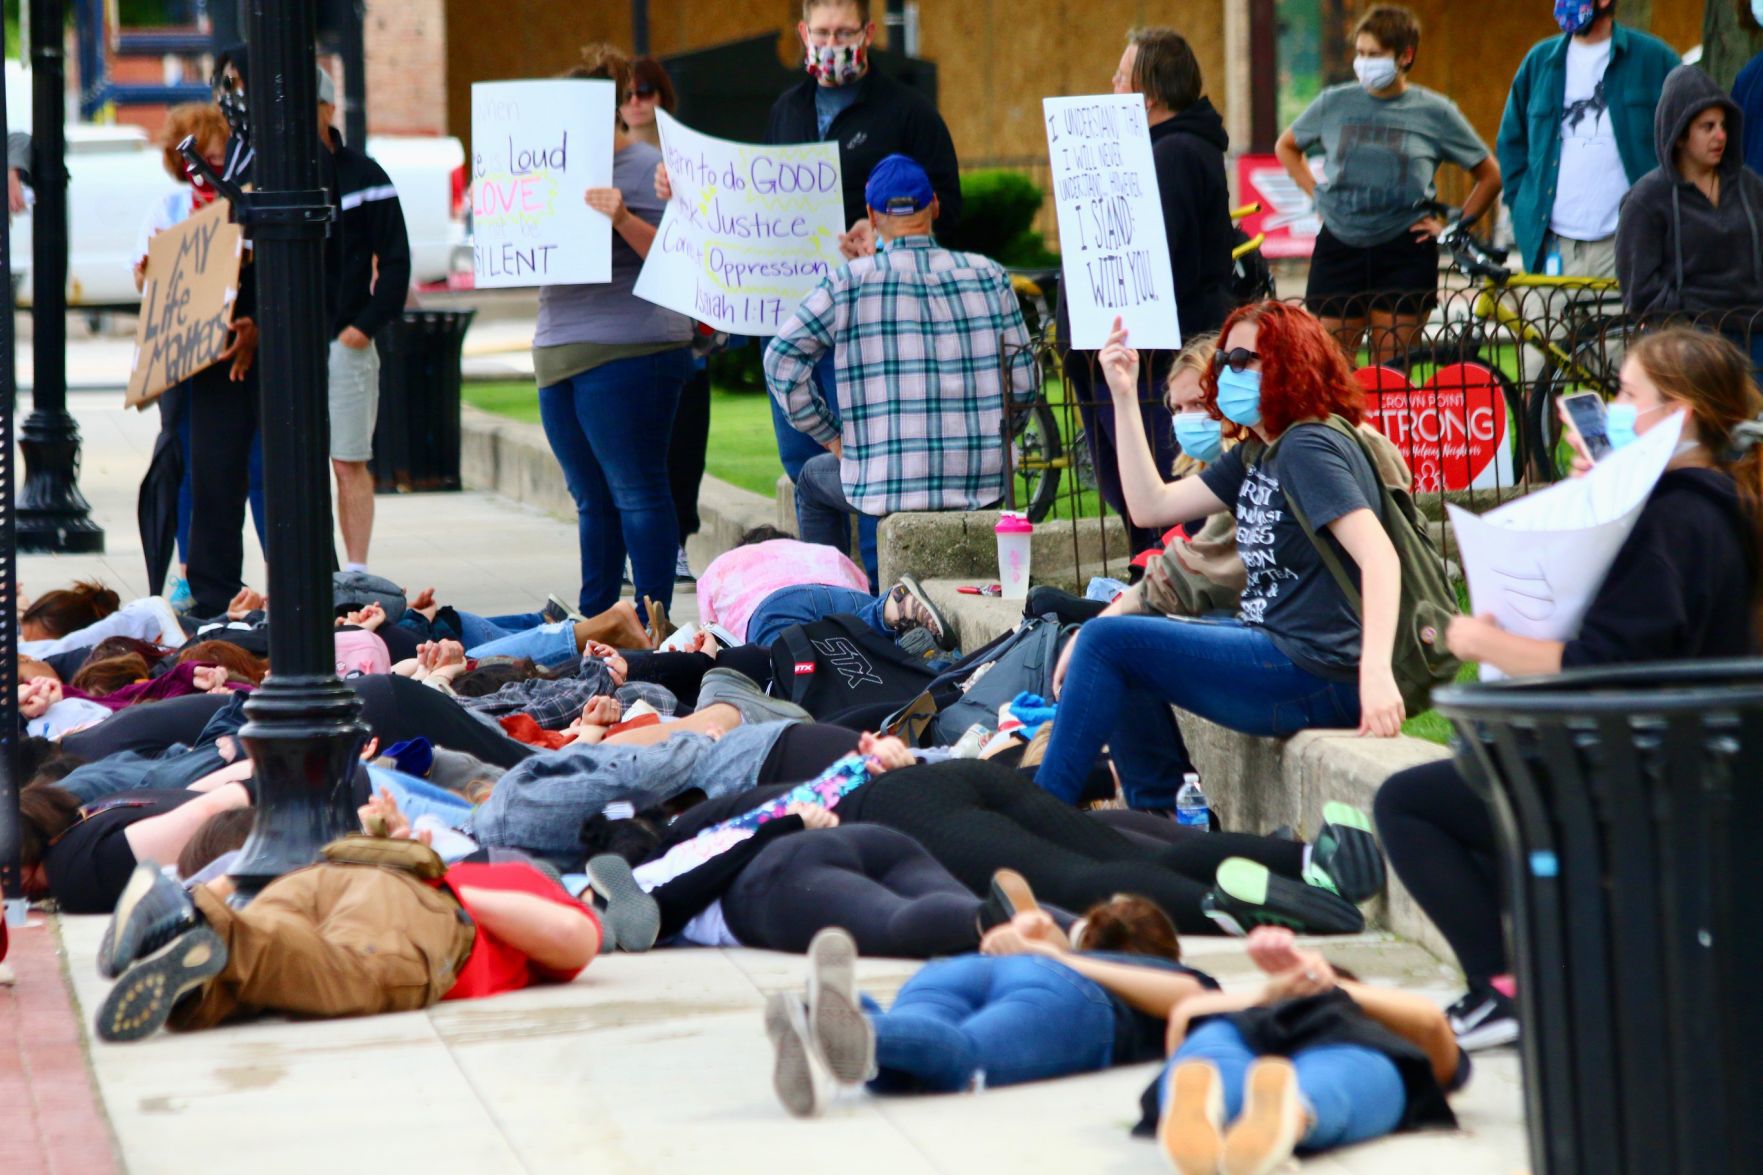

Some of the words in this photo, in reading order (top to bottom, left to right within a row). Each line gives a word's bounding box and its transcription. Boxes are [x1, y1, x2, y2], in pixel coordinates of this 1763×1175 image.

[1048, 114, 1058, 142] I
[508, 130, 568, 175] Loud
[697, 152, 717, 187] to
[722, 161, 746, 191] do
[1075, 204, 1087, 251] I
[1087, 255, 1128, 308] WITH
[744, 297, 786, 326] 1:17
[1442, 442, 1481, 460] Neighors
